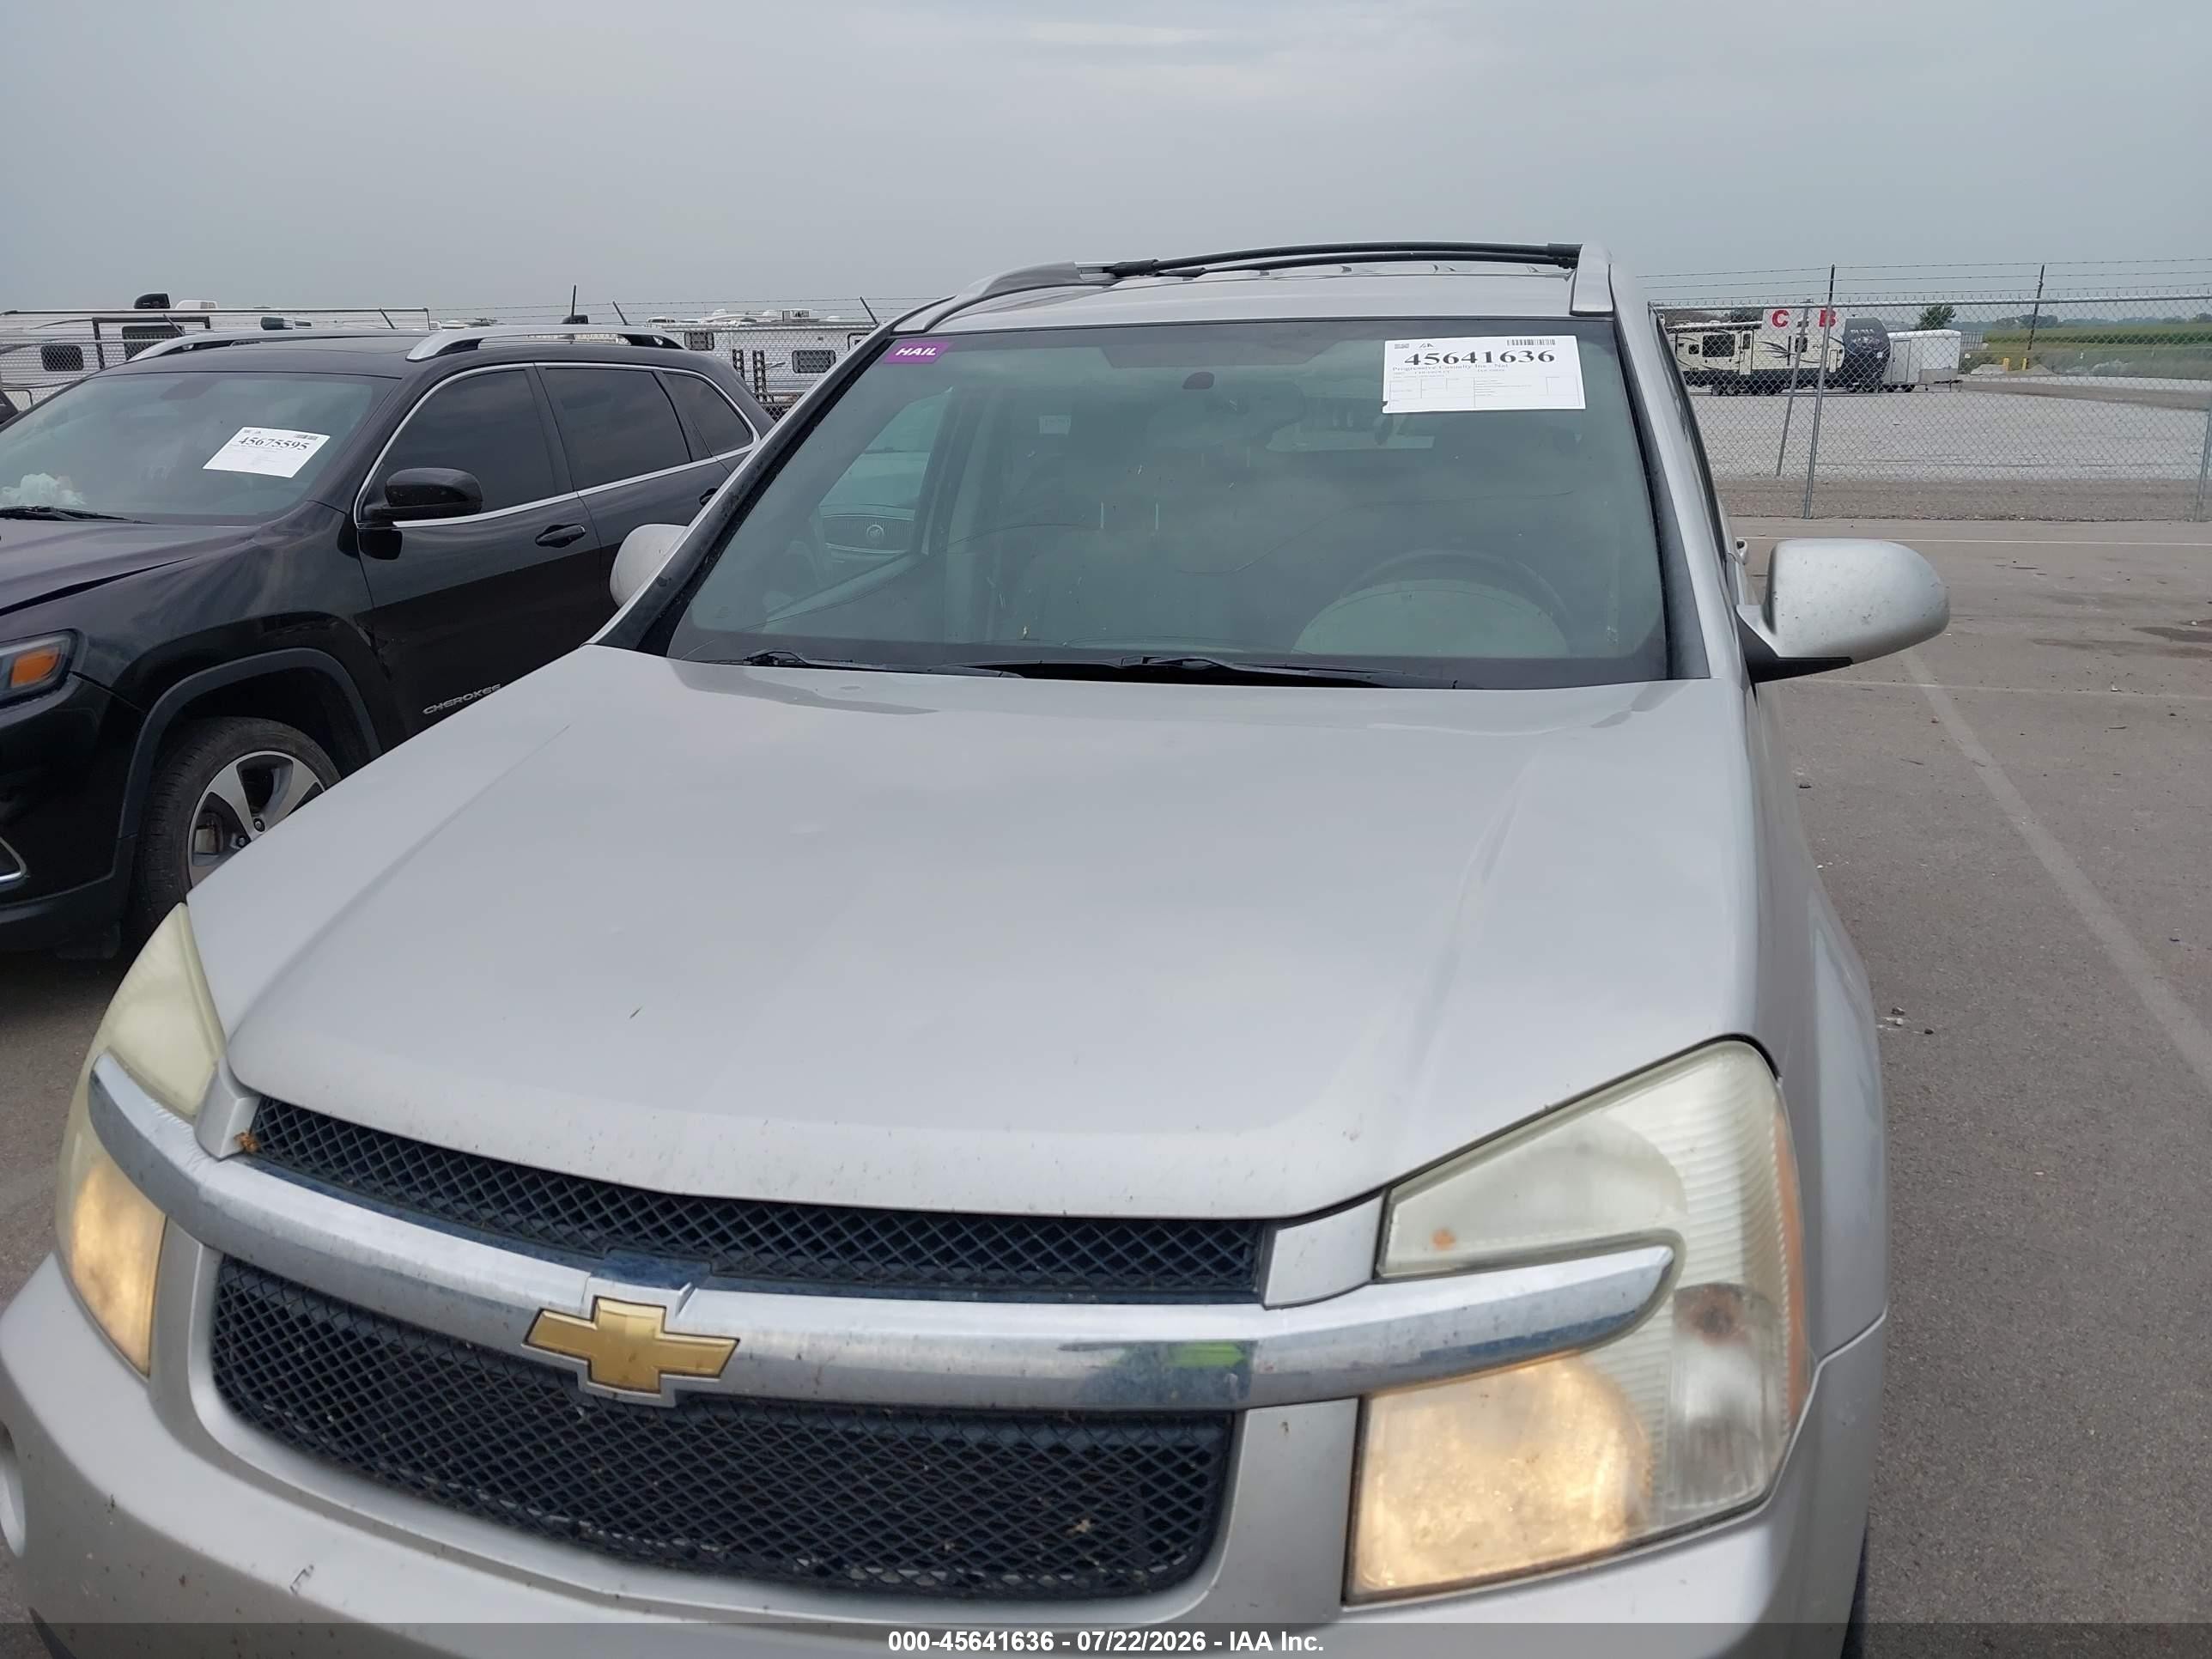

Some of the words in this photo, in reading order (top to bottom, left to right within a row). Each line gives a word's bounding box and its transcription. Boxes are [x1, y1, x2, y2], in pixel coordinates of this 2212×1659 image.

[895, 347, 938, 356] HAIL
[1404, 349, 1556, 367] 45641636
[239, 436, 309, 450] 45675595
